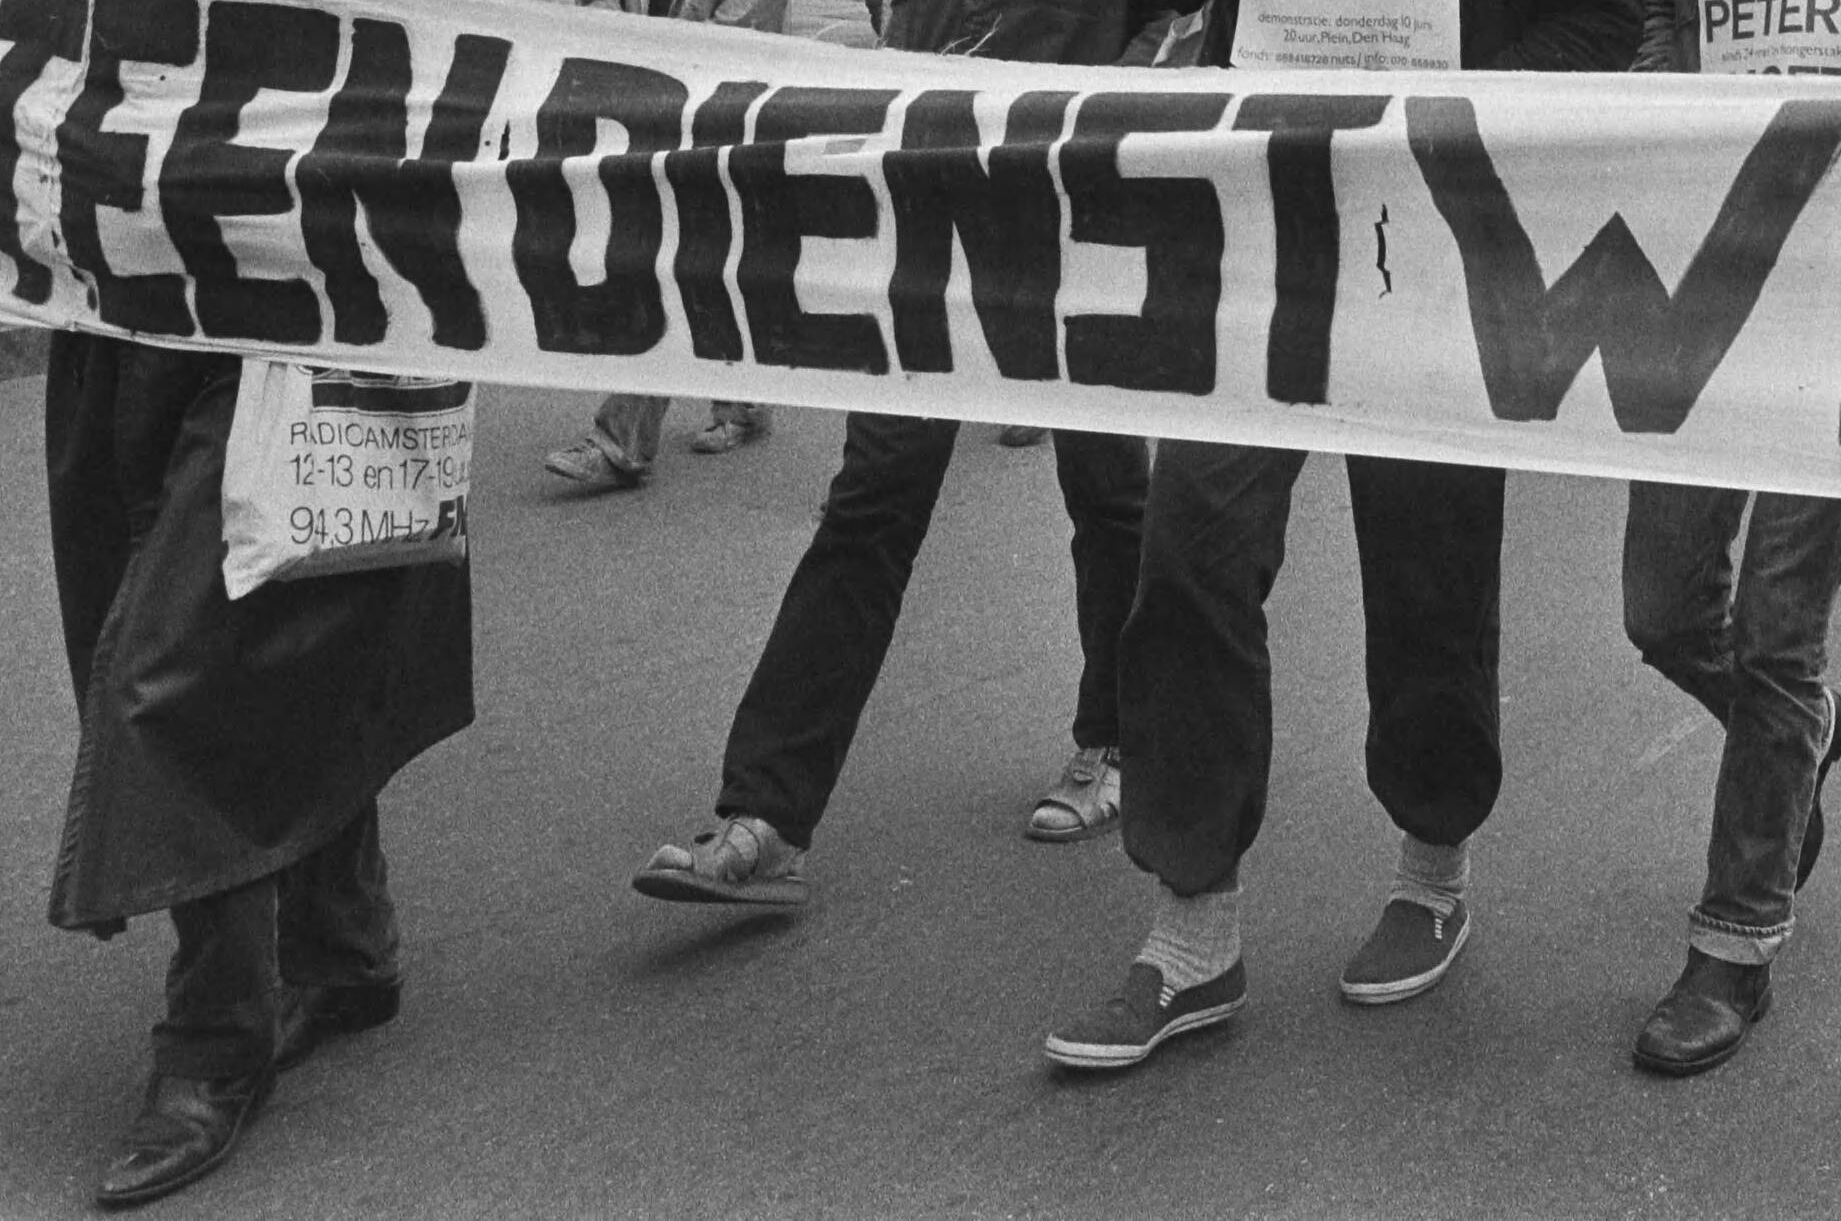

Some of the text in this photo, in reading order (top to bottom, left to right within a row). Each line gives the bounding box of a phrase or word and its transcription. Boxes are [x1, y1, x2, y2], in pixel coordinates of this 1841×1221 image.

[1335, 15, 1399, 30] donderdag
[1283, 28, 1297, 43] 20
[1351, 31, 1379, 45] Den
[289, 452, 355, 488] 12-13
[363, 464, 393, 490] en
[361, 509, 430, 545] MHz
